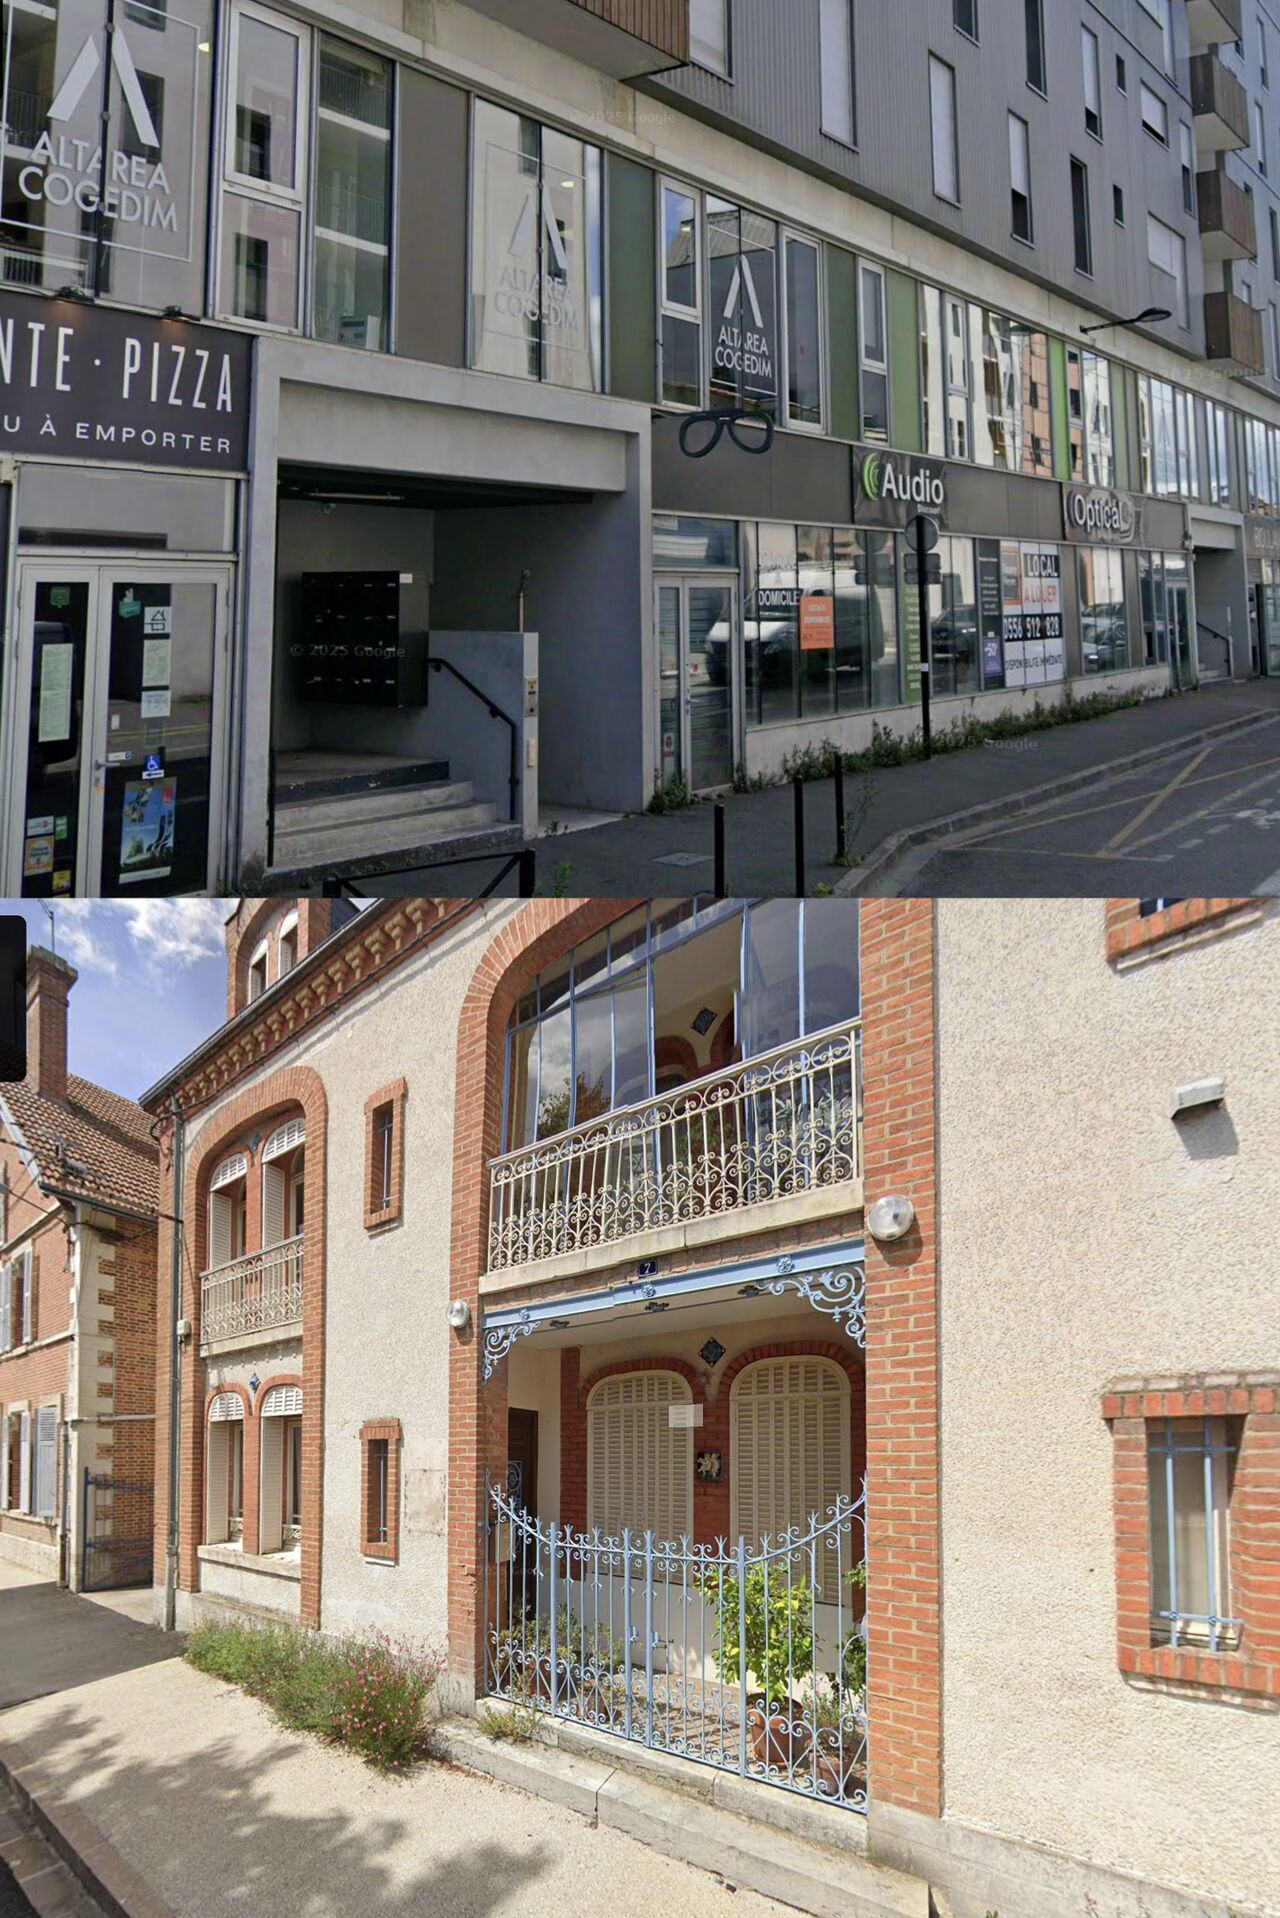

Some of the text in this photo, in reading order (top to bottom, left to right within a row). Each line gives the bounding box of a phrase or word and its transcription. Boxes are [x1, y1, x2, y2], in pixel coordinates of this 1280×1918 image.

[30, 130, 171, 195] ALTAREA
[18, 165, 178, 233] COGEDIM
[500, 265, 574, 304] ALTAREA
[494, 290, 578, 332] COGEDIM
[122, 337, 232, 412] PIZZA
[715, 346, 772, 379] COGEDIM
[39, 414, 57, 436] À
[76, 422, 231, 454] EMPORTER
[881, 463, 944, 505] Audio
[1074, 494, 1124, 533] Optical
[1027, 555, 1058, 577] LOCAL
[758, 590, 800, 606] DOMICILE
[1003, 617, 1023, 640] 0556
[1026, 616, 1041, 638] 512
[643, 1262, 651, 1274] 7
